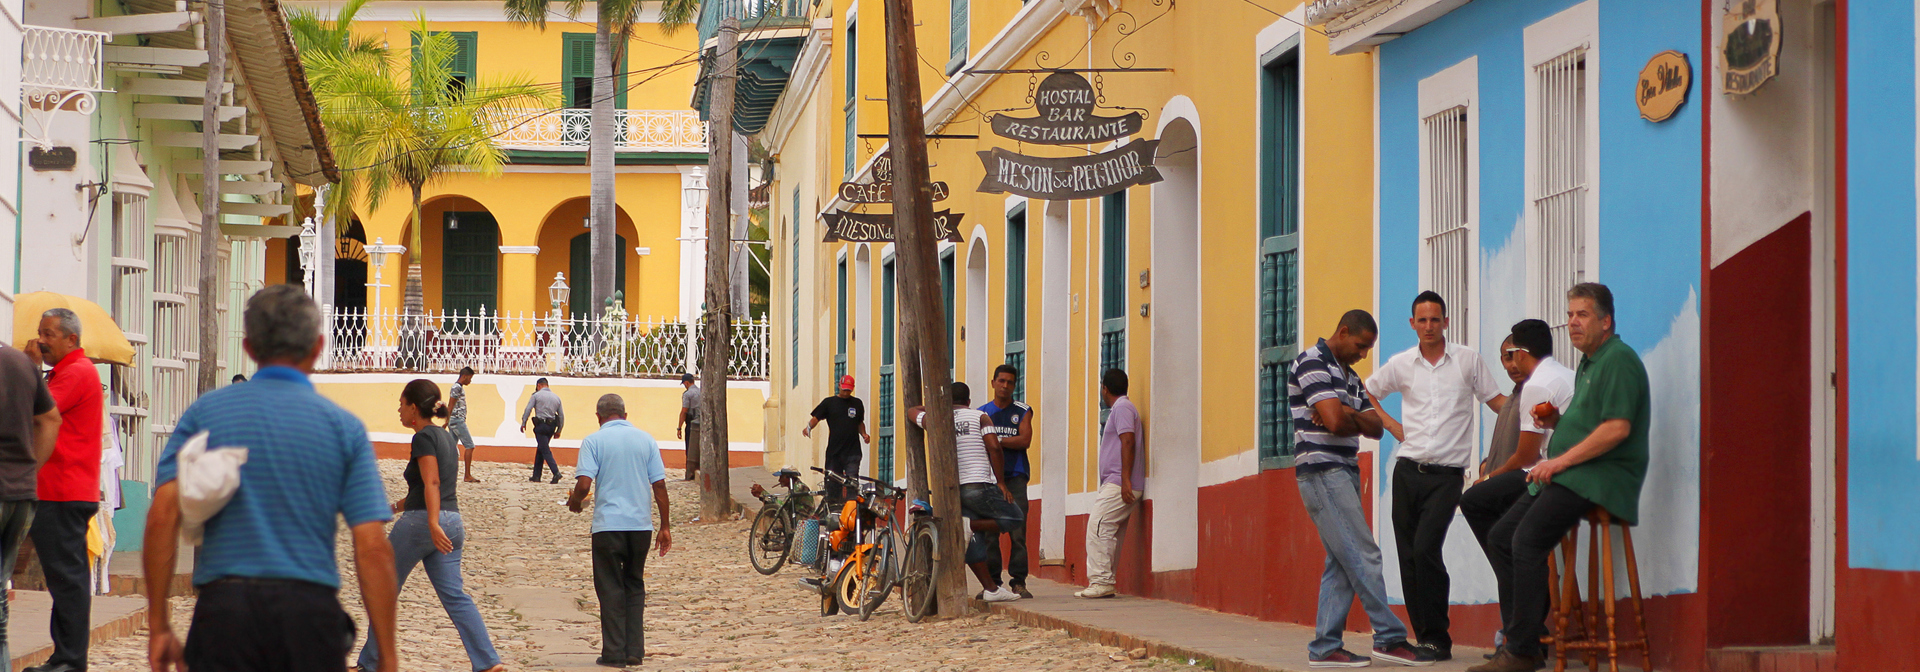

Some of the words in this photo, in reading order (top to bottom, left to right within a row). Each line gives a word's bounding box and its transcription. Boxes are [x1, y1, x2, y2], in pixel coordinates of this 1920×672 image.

[1040, 89, 1092, 105] HOSTAL
[1048, 107, 1085, 122] BAR
[1005, 118, 1128, 140] RESTAURANTE
[997, 156, 1053, 193] MESON
[1053, 173, 1073, 189] del
[1072, 150, 1144, 192] REGIDOR
[834, 215, 885, 240] MESON
